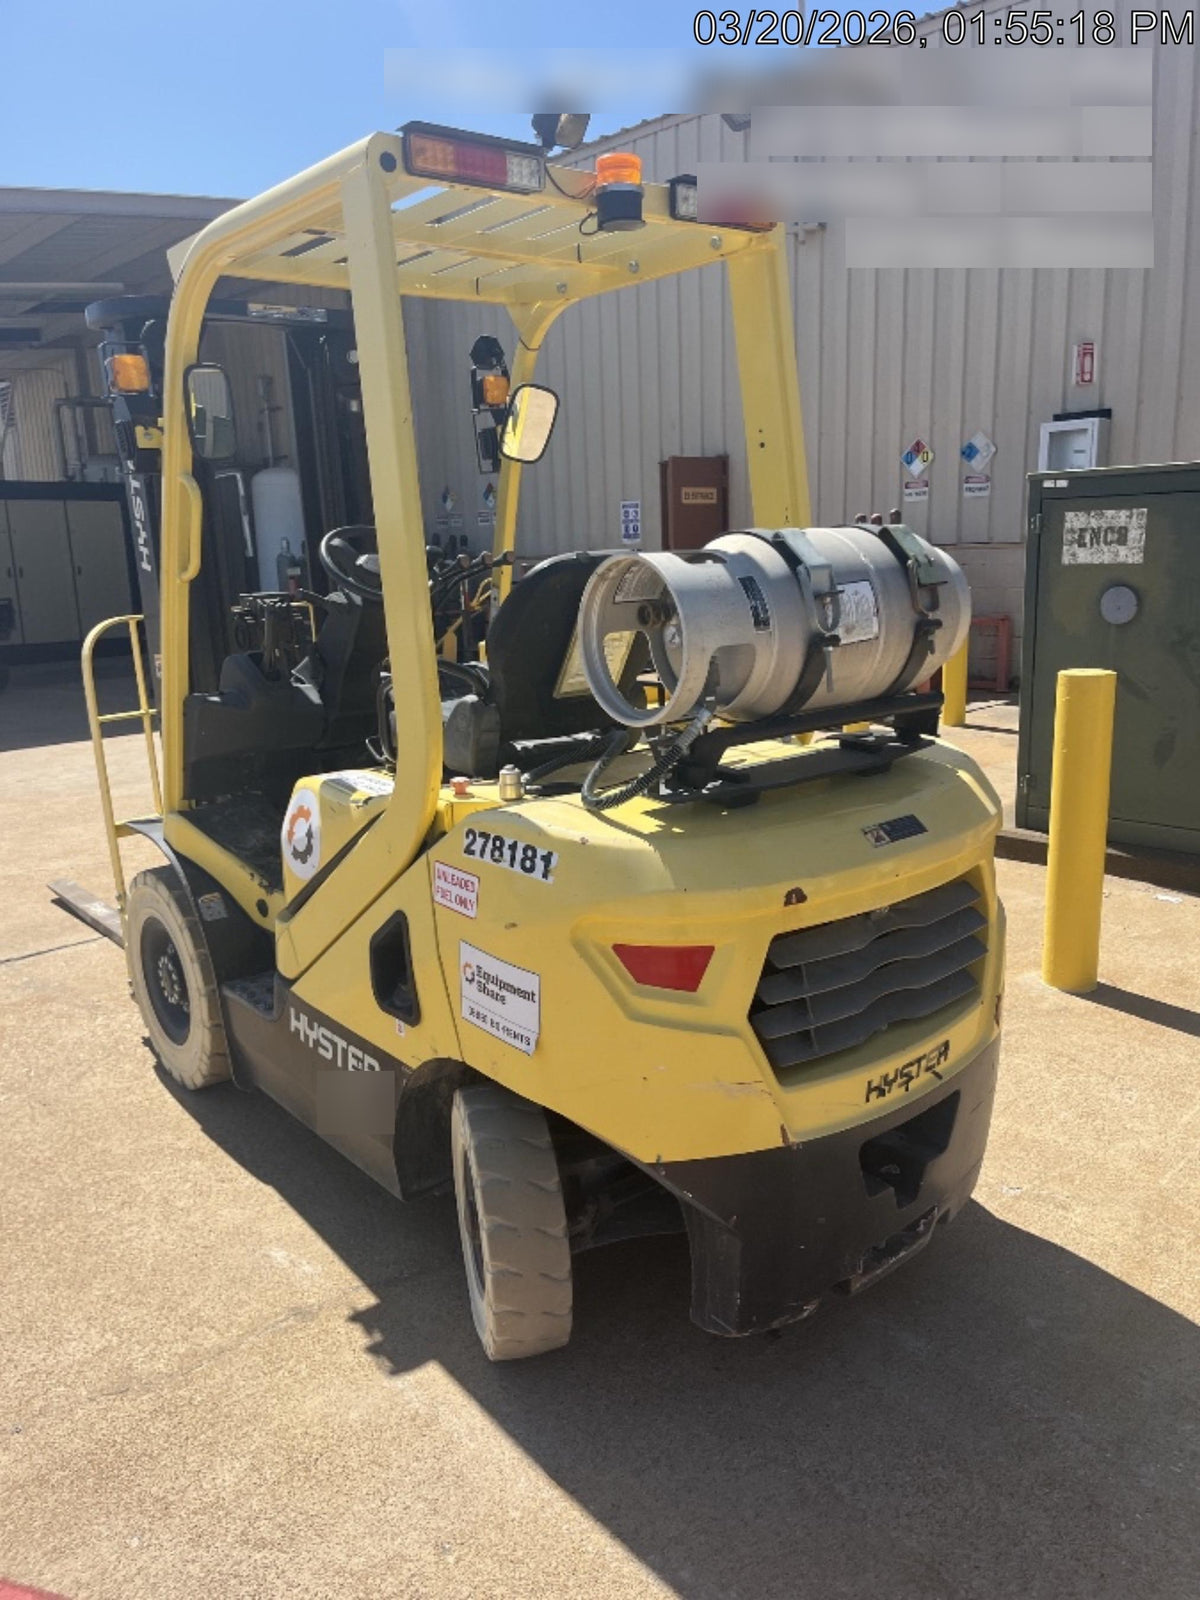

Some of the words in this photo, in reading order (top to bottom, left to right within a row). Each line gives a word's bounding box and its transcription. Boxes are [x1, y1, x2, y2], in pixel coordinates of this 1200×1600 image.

[463, 827, 554, 881] 278181
[454, 893, 475, 911] ONLY
[476, 964, 537, 1003] Equipment
[476, 980, 507, 1005] Share
[865, 1039, 950, 1103] HYSTER
